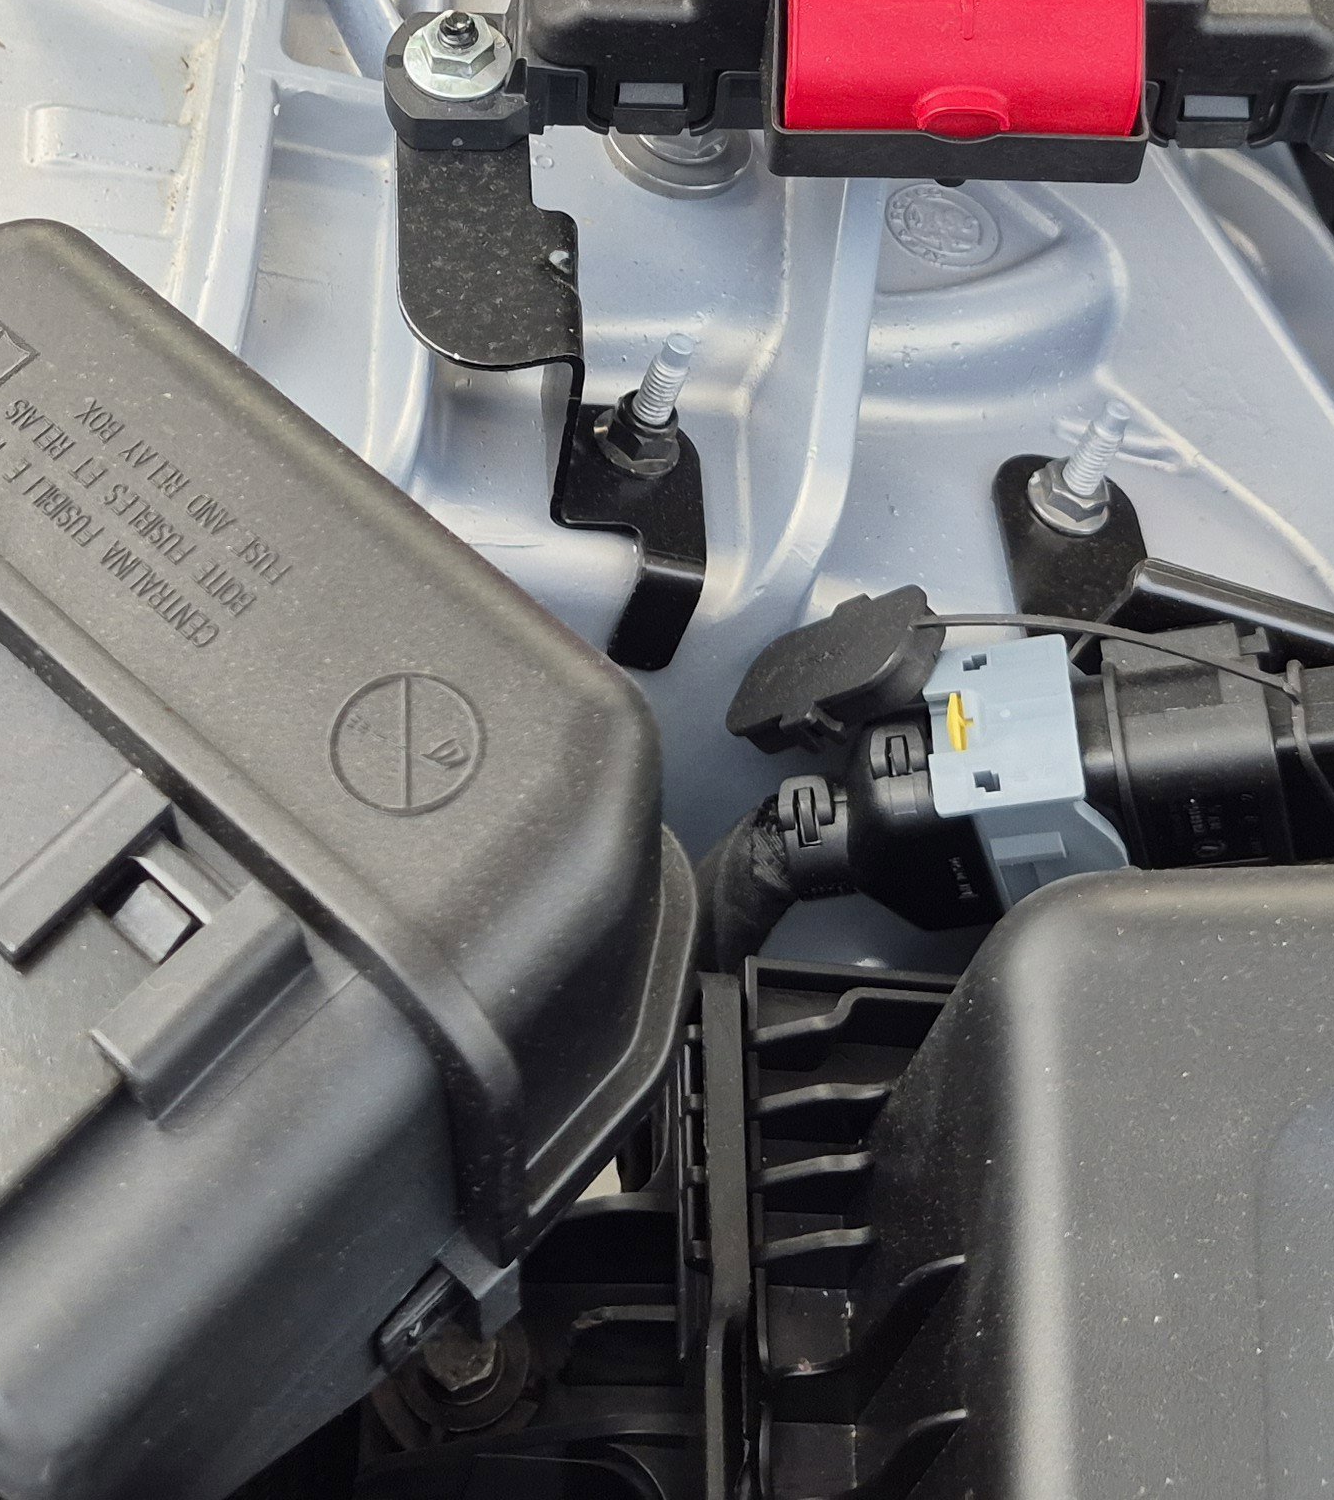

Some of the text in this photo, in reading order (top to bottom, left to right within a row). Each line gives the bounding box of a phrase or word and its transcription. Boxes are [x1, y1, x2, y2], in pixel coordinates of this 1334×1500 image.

[2, 457, 33, 484] E
[5, 399, 257, 617] BOITE FUSIBLES ET RELAIS
[22, 476, 105, 548] FUSIBILI
[73, 399, 294, 586] FUSE AND RELAY BOX
[100, 540, 220, 648] CENTRALINA
